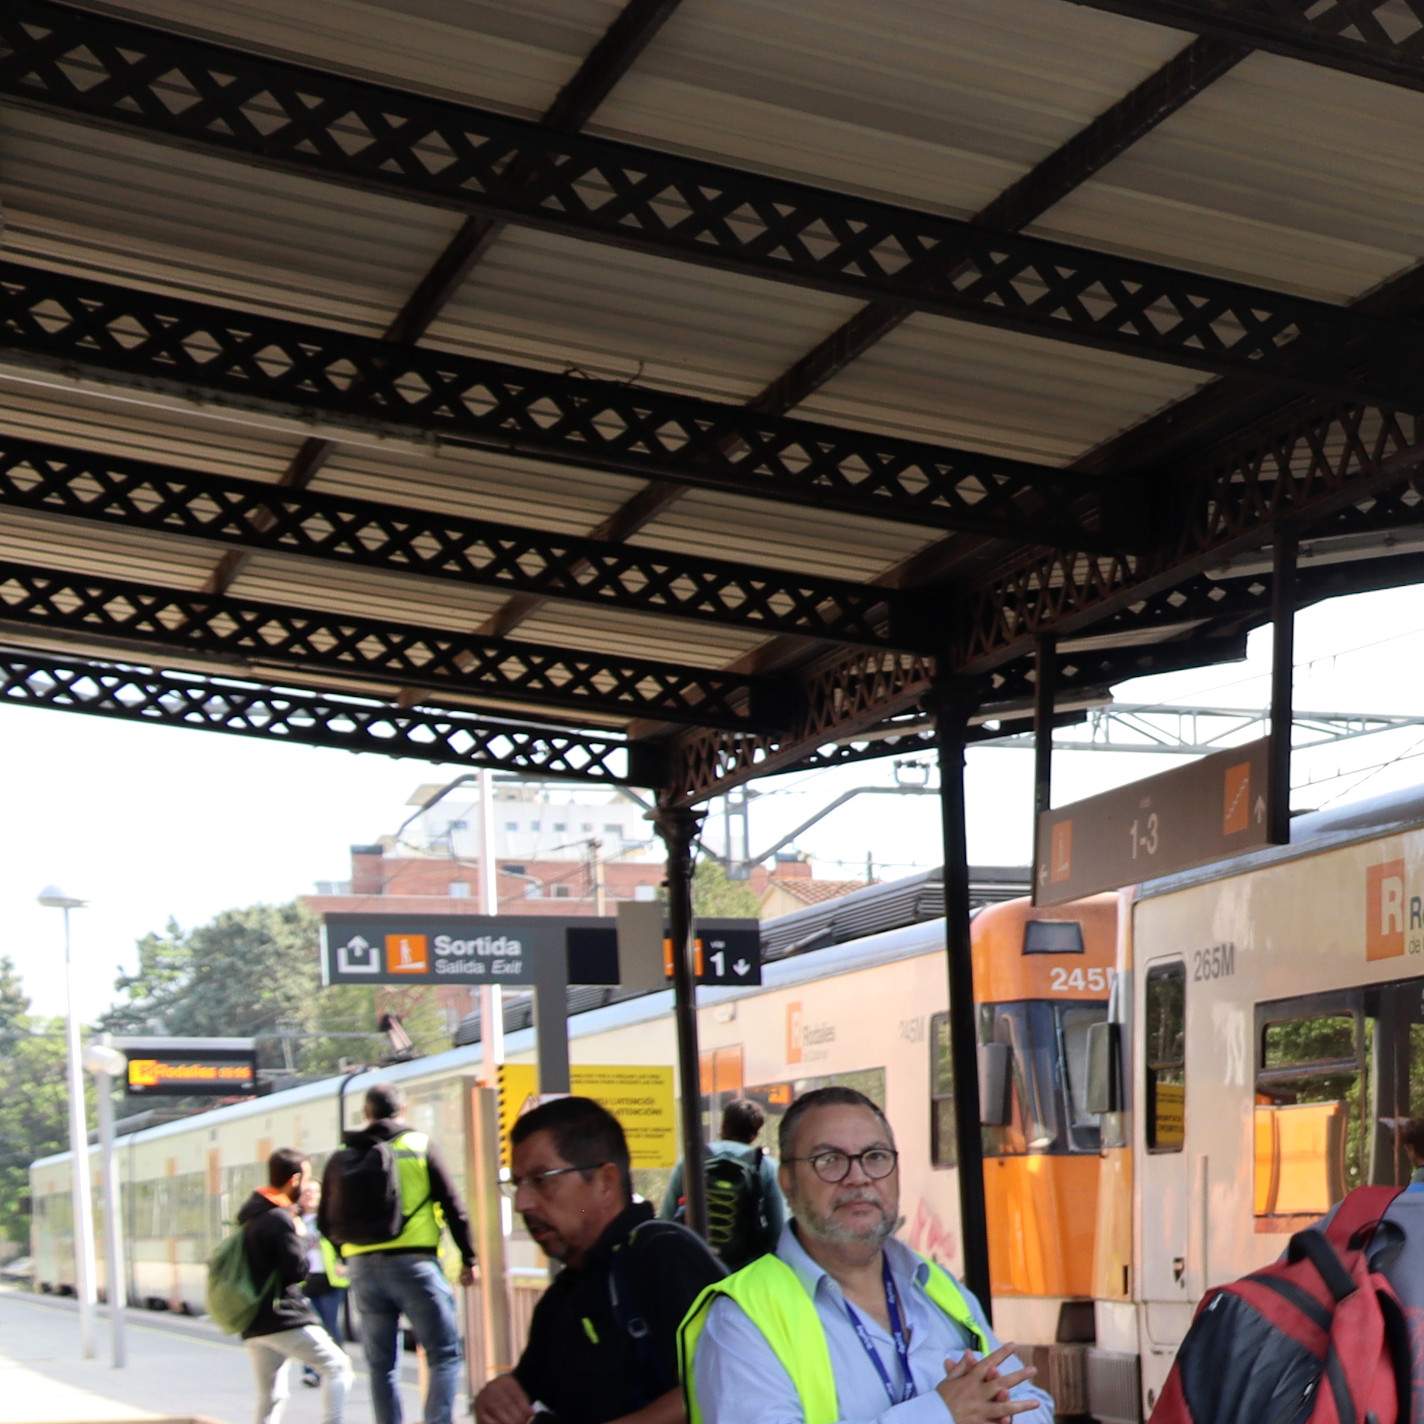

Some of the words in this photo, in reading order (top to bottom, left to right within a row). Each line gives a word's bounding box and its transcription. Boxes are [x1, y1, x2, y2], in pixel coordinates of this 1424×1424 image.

[1129, 812, 1159, 860] 1-3
[433, 934, 523, 957] Sortida
[1408, 935, 1421, 955] de
[434, 958, 485, 975] Salida
[491, 958, 523, 974] Exit
[709, 950, 726, 977] 1
[1193, 942, 1235, 982] 265M
